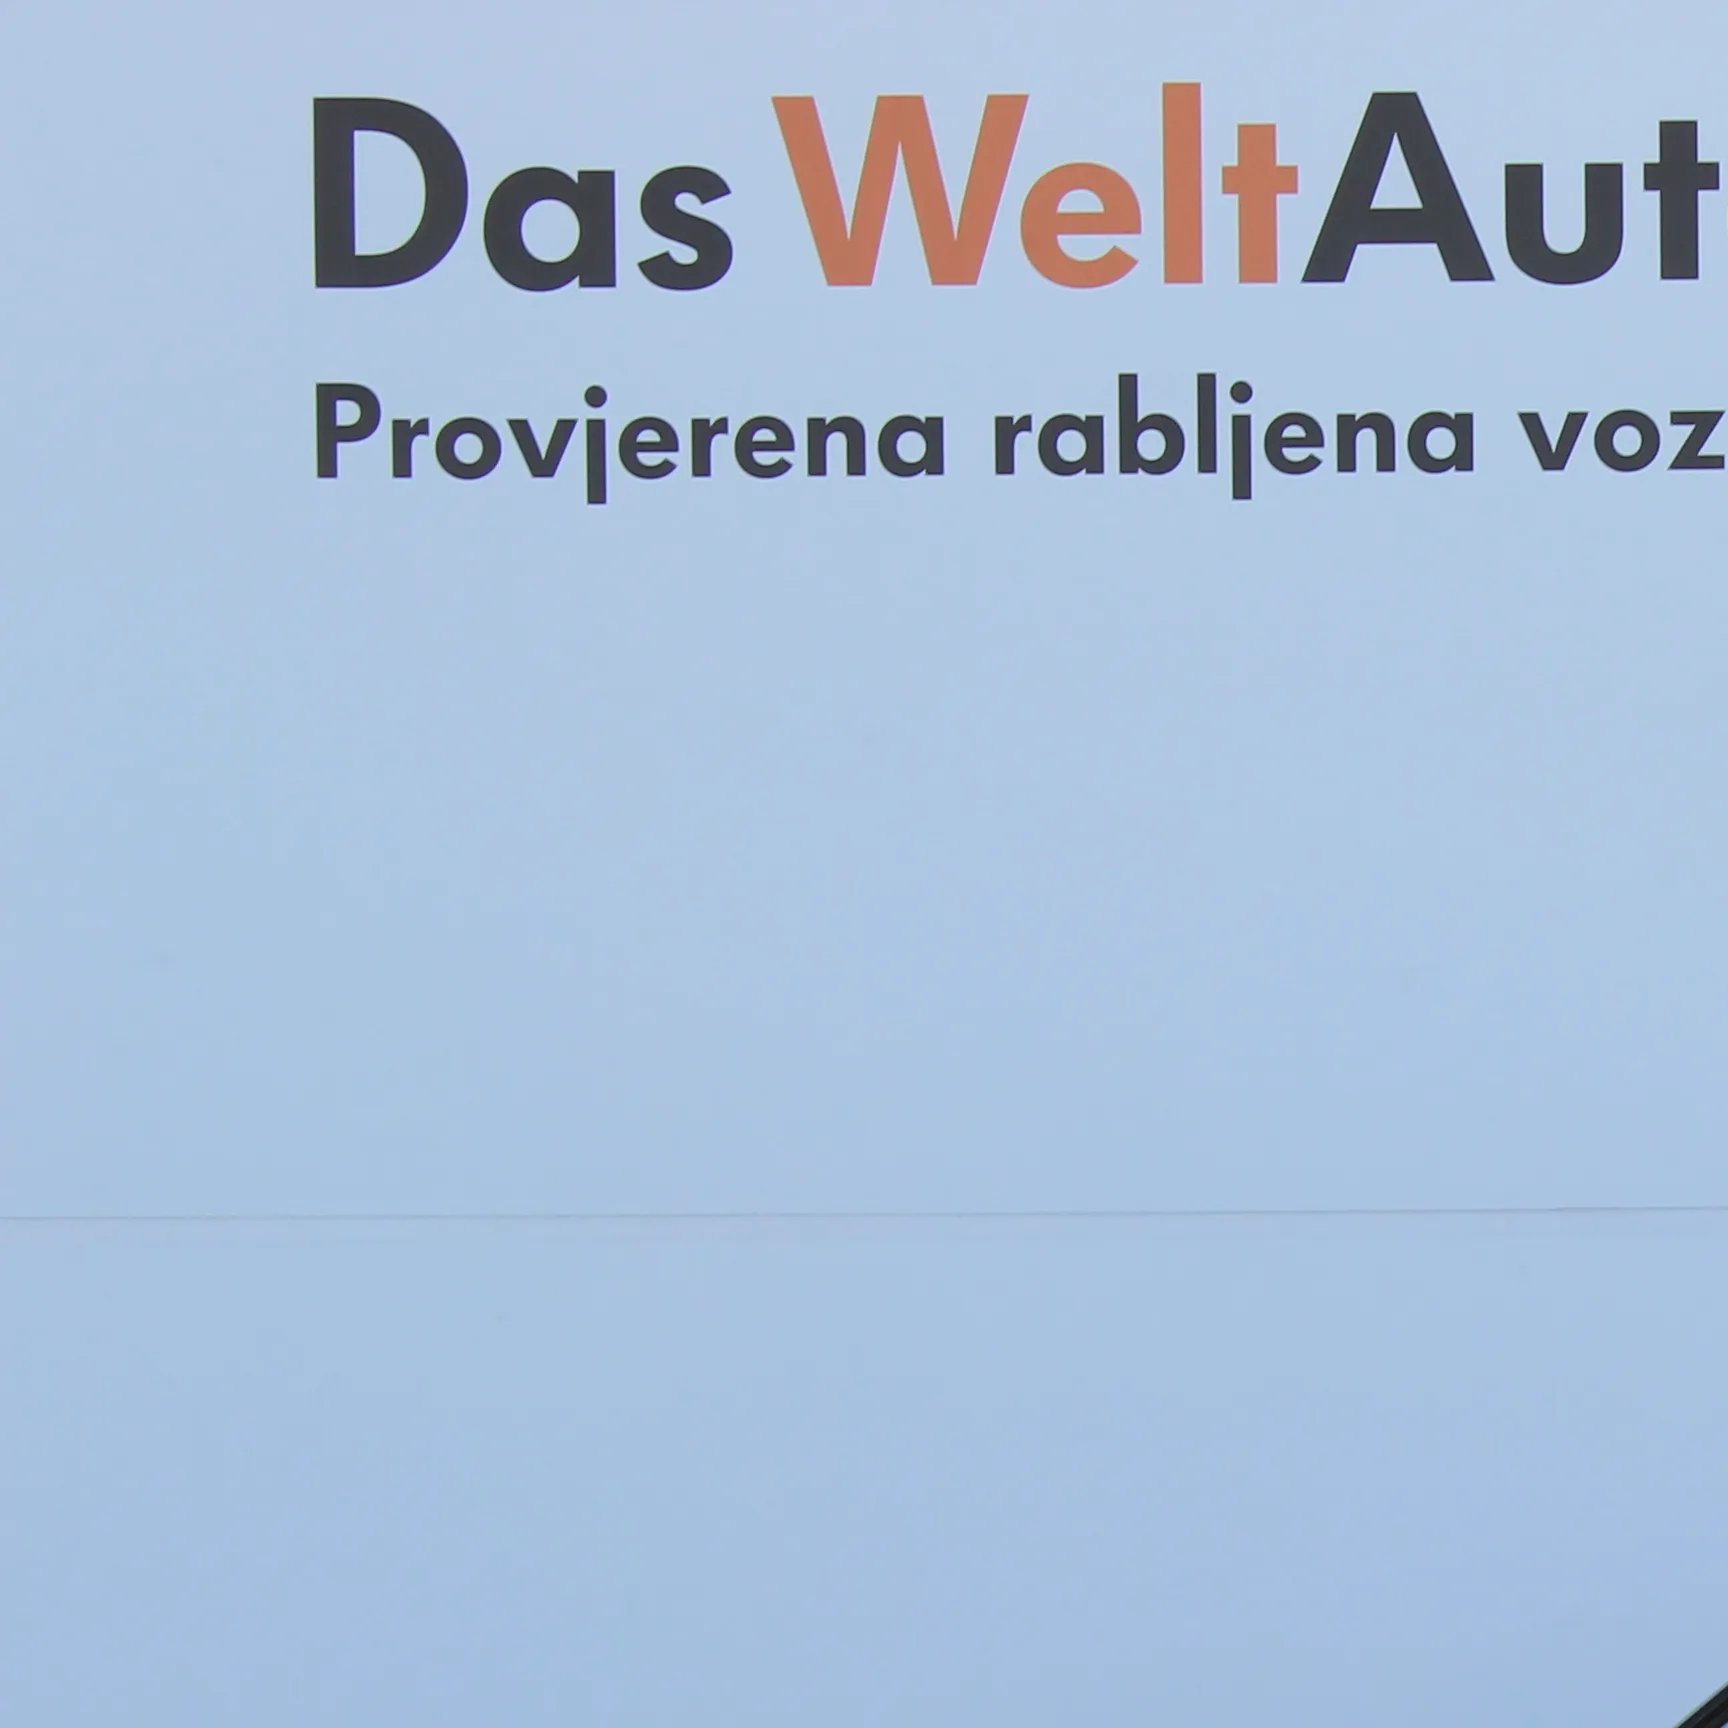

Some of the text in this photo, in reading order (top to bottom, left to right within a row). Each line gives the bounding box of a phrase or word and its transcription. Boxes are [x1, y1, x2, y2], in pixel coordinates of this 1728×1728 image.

[313, 98, 732, 292] Das
[316, 383, 944, 504] Provjerena
[995, 373, 1473, 500] rabljena
